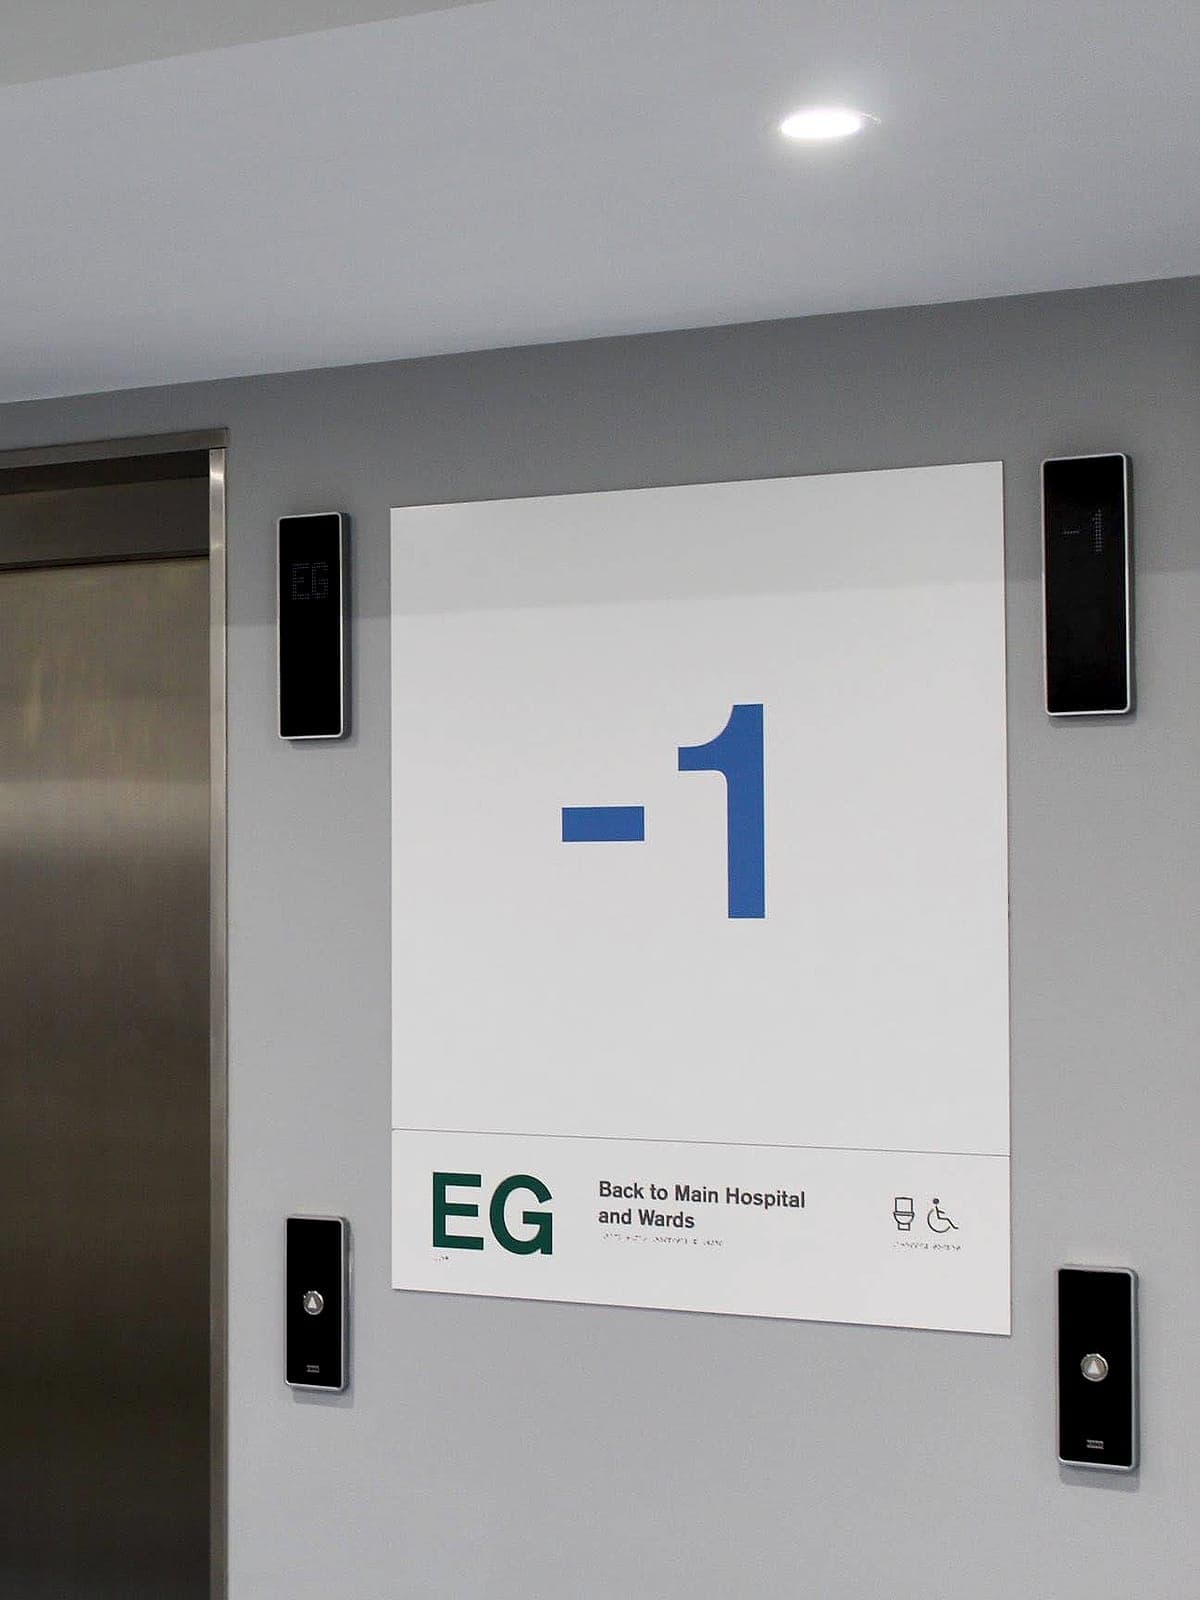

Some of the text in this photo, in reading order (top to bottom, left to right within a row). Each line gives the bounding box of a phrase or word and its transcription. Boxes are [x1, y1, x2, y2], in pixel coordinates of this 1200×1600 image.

[291, 562, 329, 600] EG
[562, 704, 765, 919] -1
[432, 1171, 553, 1256] EG
[599, 1180, 806, 1210] Back to Main Hospital
[598, 1207, 696, 1229] and Wards
